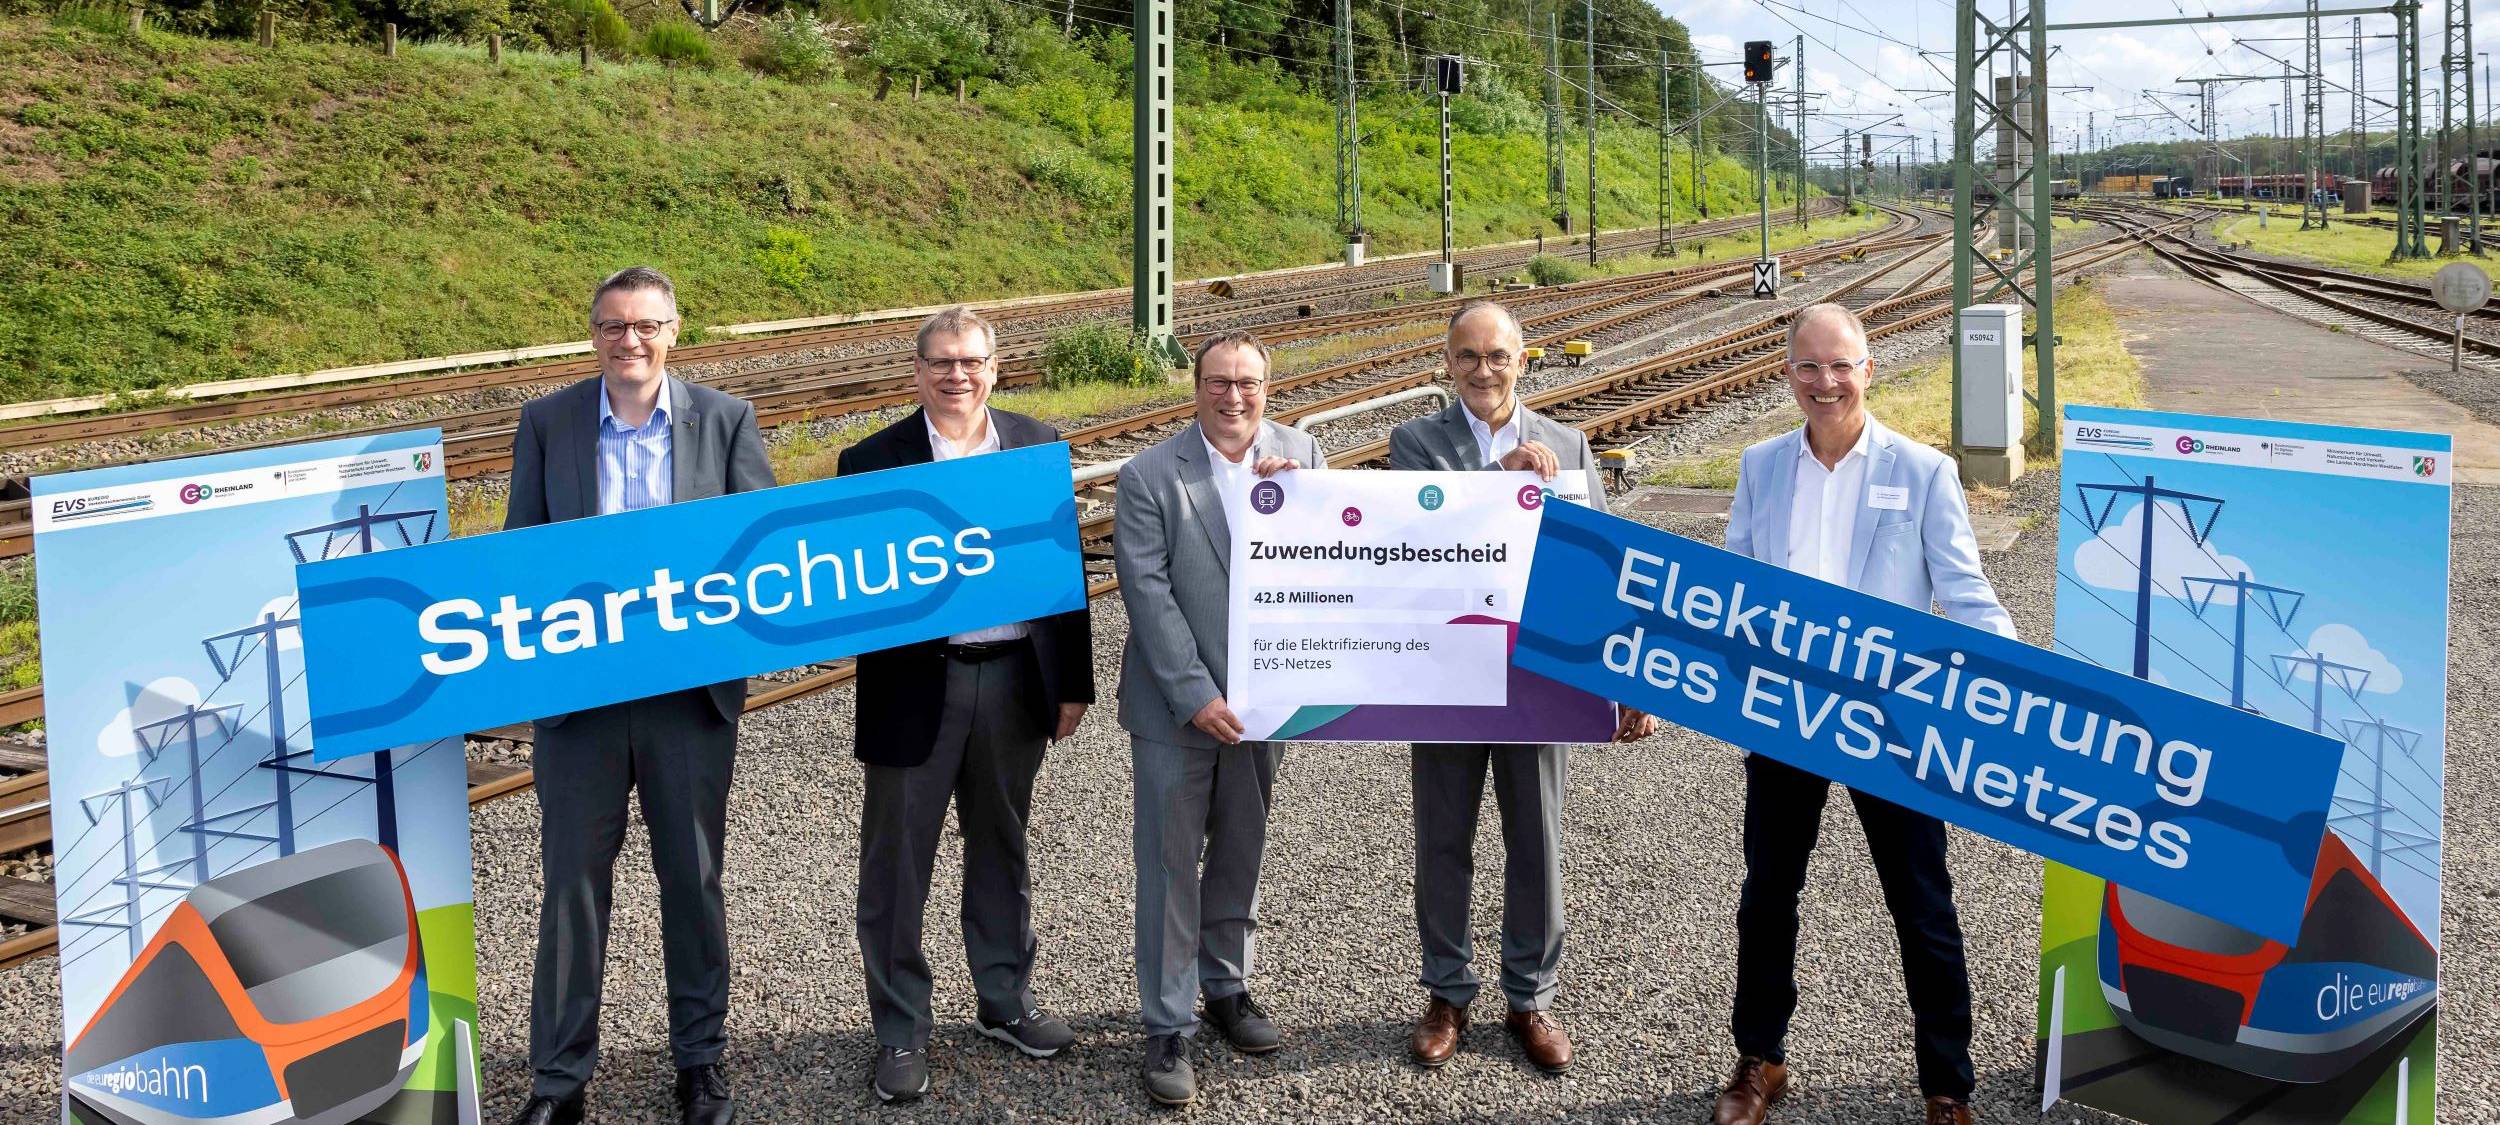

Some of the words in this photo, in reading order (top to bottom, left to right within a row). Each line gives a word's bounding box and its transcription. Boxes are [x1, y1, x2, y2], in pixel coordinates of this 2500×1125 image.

[1969, 333, 1994, 342] KS0942
[2077, 427, 2102, 438] EVS
[2205, 444, 2241, 453] RHEINLAND
[214, 483, 254, 494] RHEINLAND
[53, 498, 86, 513] EVS
[1249, 541, 1507, 565] Zuwendungsbescheid
[418, 526, 995, 676] Startschuss
[1254, 591, 1285, 604] 42.8
[1288, 591, 1354, 603] Millionen
[1485, 594, 1494, 607] €
[1253, 638, 1273, 651] für
[1276, 638, 1297, 651] die
[1301, 637, 1401, 654] Elektrifizierung
[1405, 638, 1430, 651] des
[1254, 657, 1332, 670] EVS-Netzes
[1616, 547, 2213, 807] Elektrifizierung
[1602, 626, 1719, 704] des
[1741, 665, 2191, 869] EVS-Netzes
[2316, 972, 2364, 1021] die
